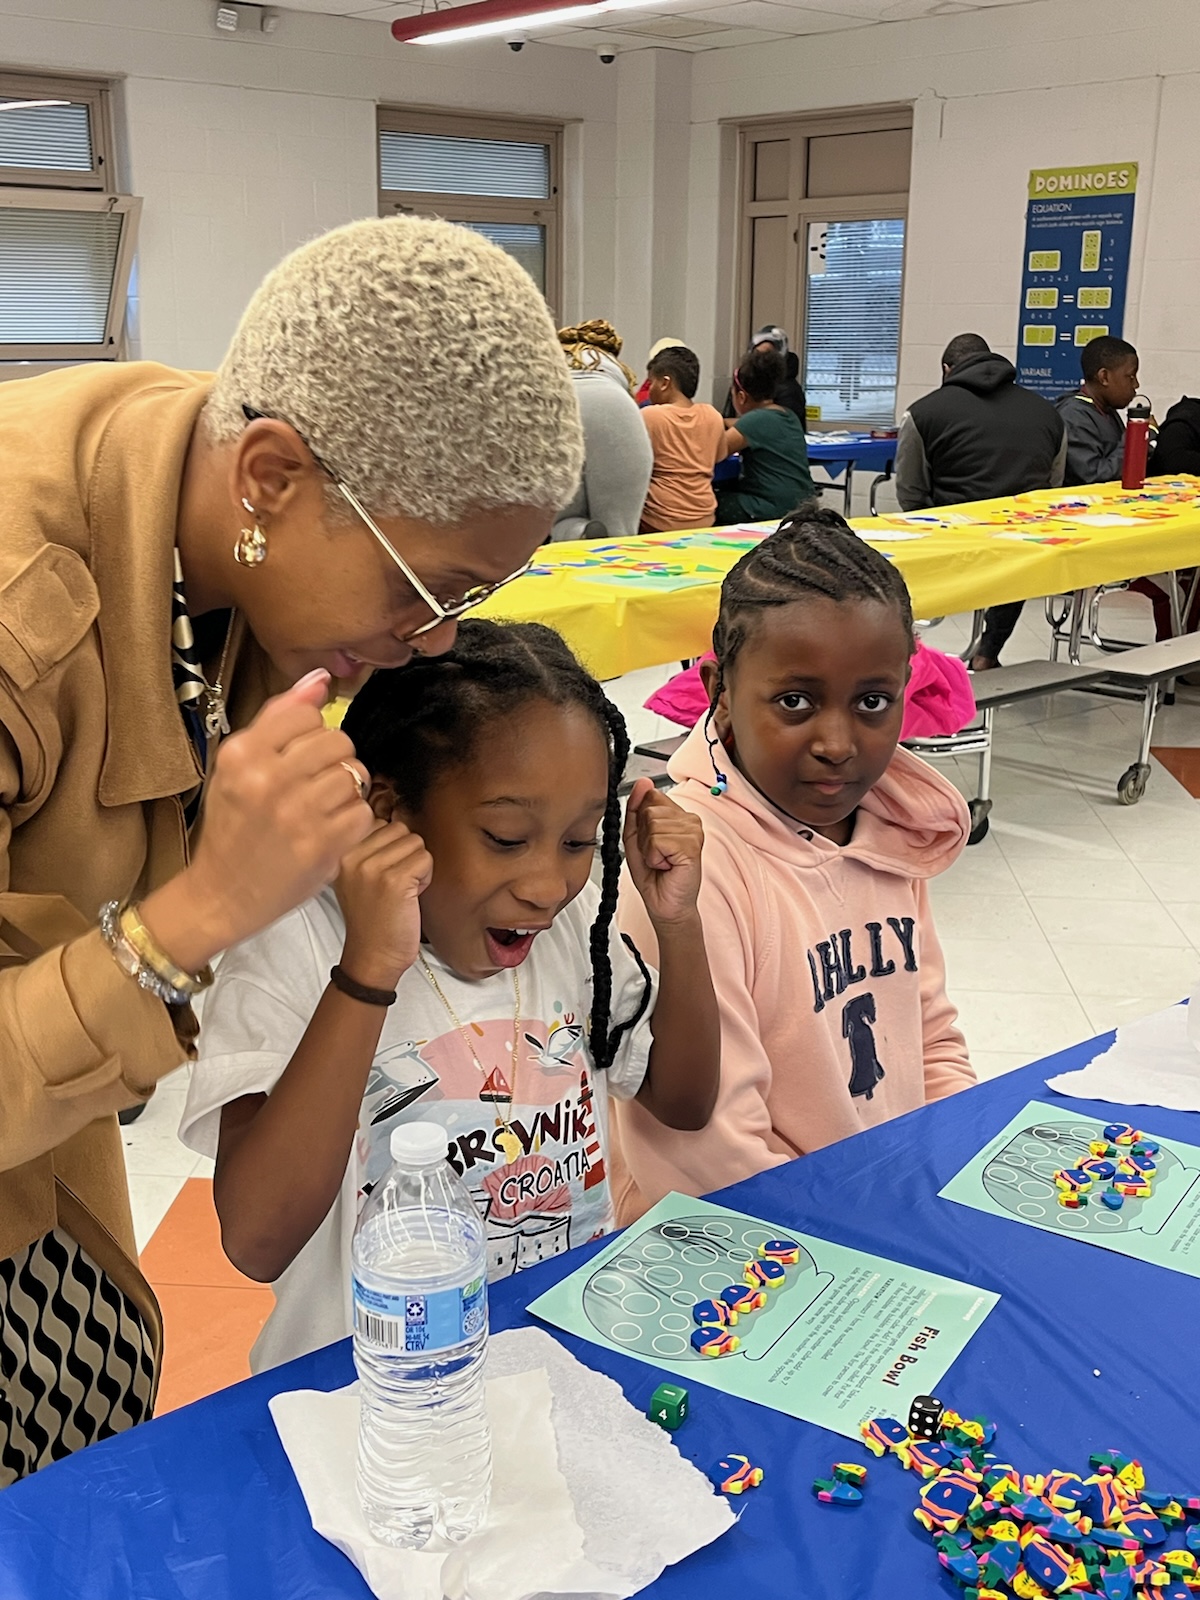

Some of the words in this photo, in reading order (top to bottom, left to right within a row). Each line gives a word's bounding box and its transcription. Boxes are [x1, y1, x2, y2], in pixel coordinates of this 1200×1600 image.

[1035, 169, 1129, 193] DOMINOES
[1032, 203, 1072, 213] EQUATION
[1020, 367, 1052, 377] VARIABLE
[500, 1148, 591, 1205] CROATIA
[829, 1289, 840, 1300] game
[845, 1283, 859, 1297] number
[829, 1305, 839, 1314] and
[899, 1306, 912, 1320] number
[814, 1324, 822, 1332] out
[849, 1318, 862, 1326] from
[882, 1330, 893, 1340] Add
[896, 1325, 908, 1339] person
[907, 1325, 941, 1351] Fish
[795, 1338, 810, 1353] number
[810, 1336, 825, 1351] number
[832, 1333, 846, 1348] number
[801, 1350, 812, 1361] cube
[875, 1355, 885, 1364] own
[793, 1361, 803, 1371] add
[858, 1355, 872, 1370] number
[836, 1366, 850, 1380] person
[866, 1363, 878, 1375] game
[882, 1354, 918, 1387] Bowl
[841, 1383, 851, 1391] Put
[834, 1390, 844, 1399] that
[846, 1389, 860, 1399] Take
[838, 1399, 850, 1409] turns
[658, 1409, 668, 1421] 4
[680, 1404, 686, 1417] 5
